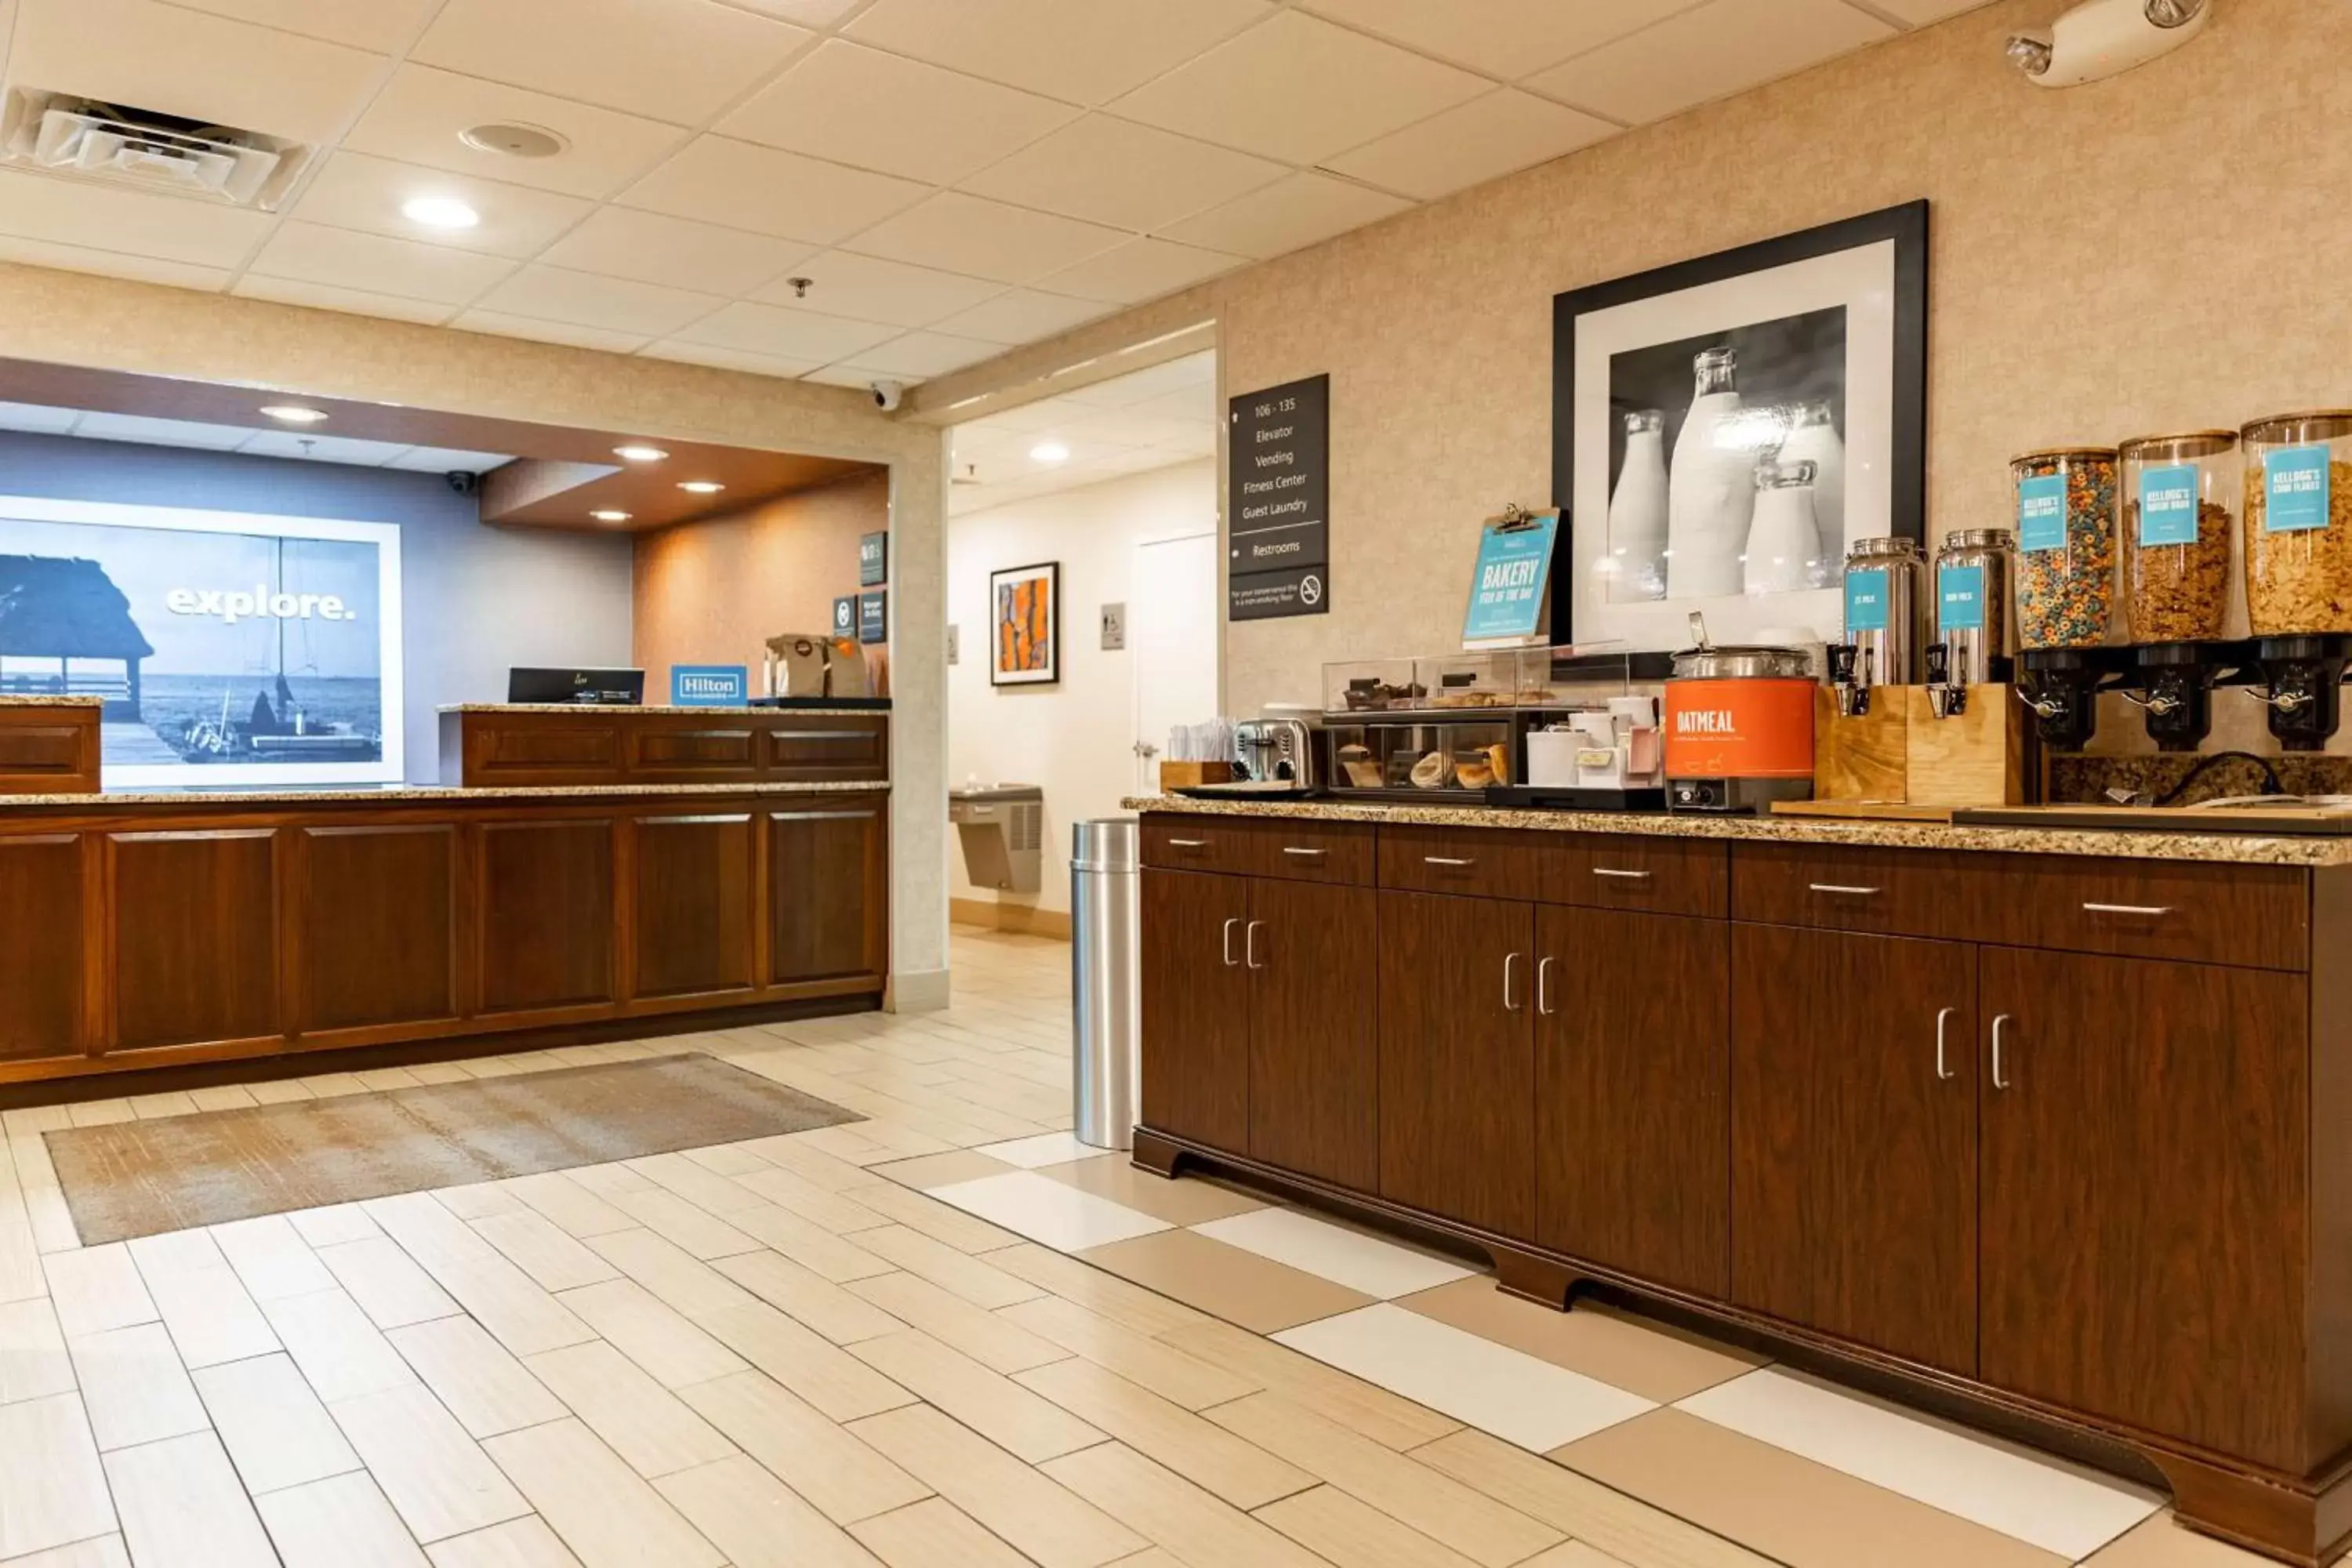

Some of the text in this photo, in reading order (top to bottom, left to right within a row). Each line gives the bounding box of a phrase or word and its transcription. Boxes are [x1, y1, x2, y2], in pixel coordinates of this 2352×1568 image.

[1279, 397, 1297, 412] 135
[1256, 426, 1293, 443] Elevator
[1255, 452, 1294, 467] Vending
[1244, 474, 1308, 495] Fitness Center
[1243, 499, 1308, 519] Guest Laundry
[1254, 542, 1300, 557] Restrooms
[1483, 558, 1540, 590] BAKERY
[166, 583, 356, 625] explore.
[684, 678, 734, 691] Hilton
[1677, 710, 1735, 732] OATMEAL
